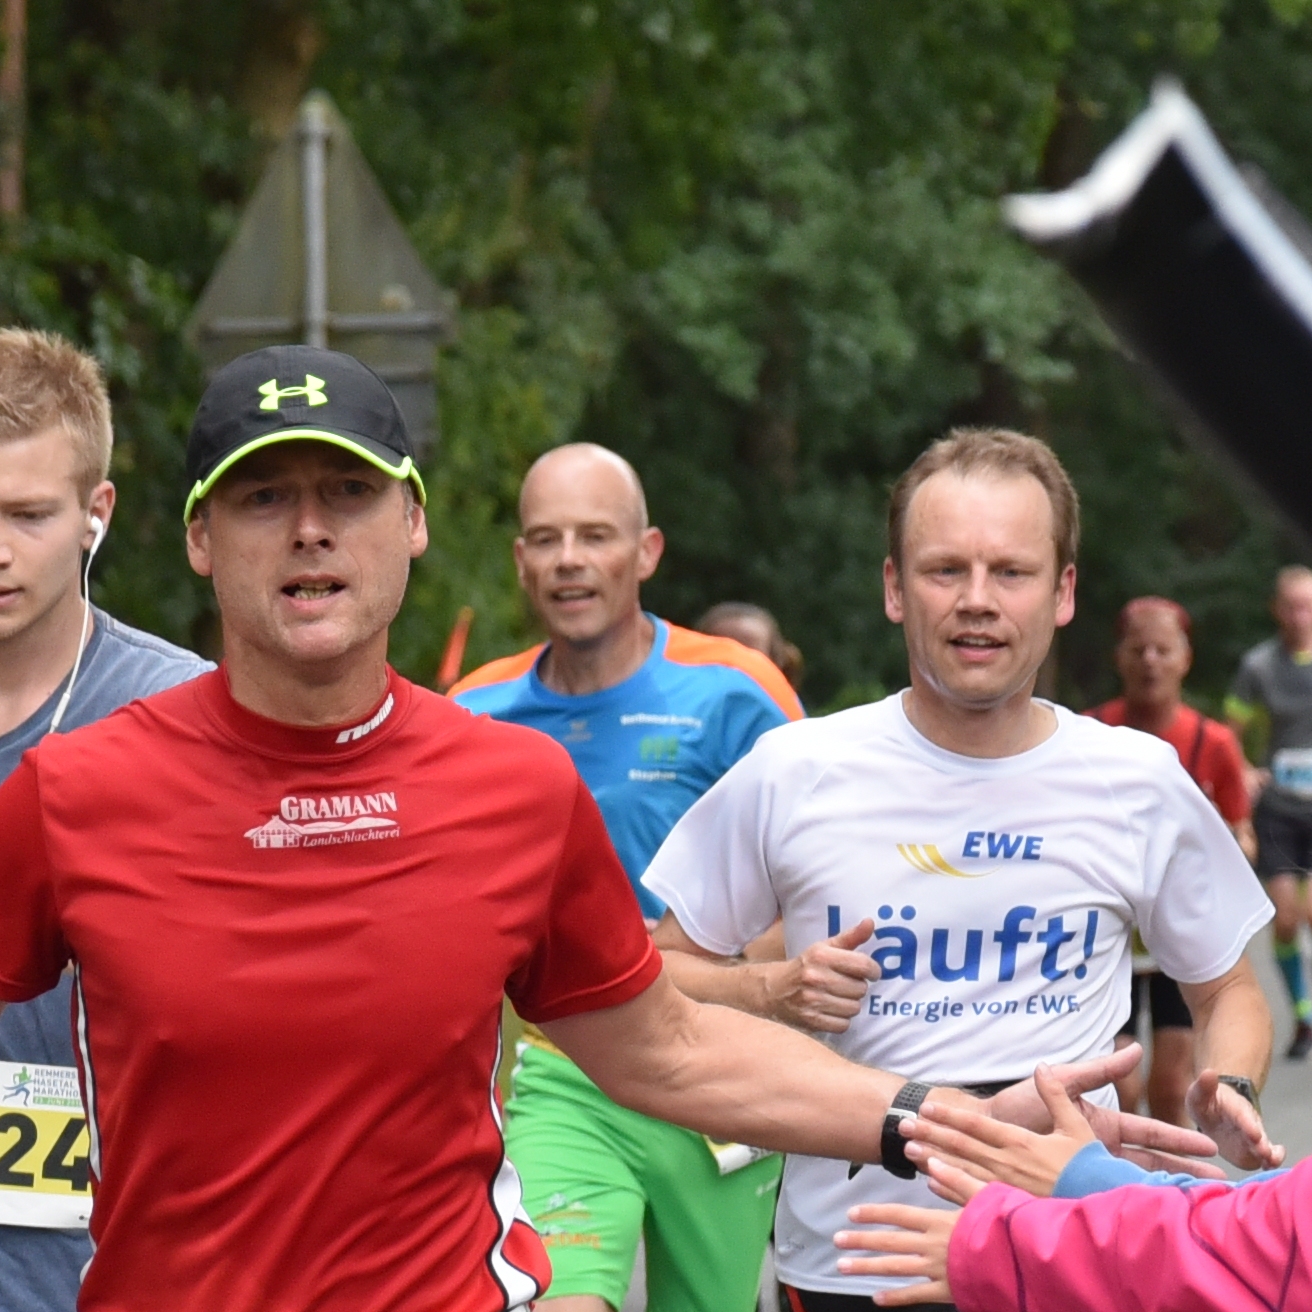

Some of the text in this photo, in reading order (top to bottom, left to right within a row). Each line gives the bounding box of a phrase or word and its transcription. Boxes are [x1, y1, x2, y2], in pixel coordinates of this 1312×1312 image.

[280, 791, 398, 821] GRAMANN
[302, 826, 401, 848] Landschlachterei
[961, 830, 1044, 861] EWE
[868, 994, 964, 1023] Energie
[971, 1000, 1019, 1015] von
[33, 1077, 75, 1089] HASETAL
[34, 1068, 77, 1080] REMMERS
[33, 1087, 79, 1098] MARATHO
